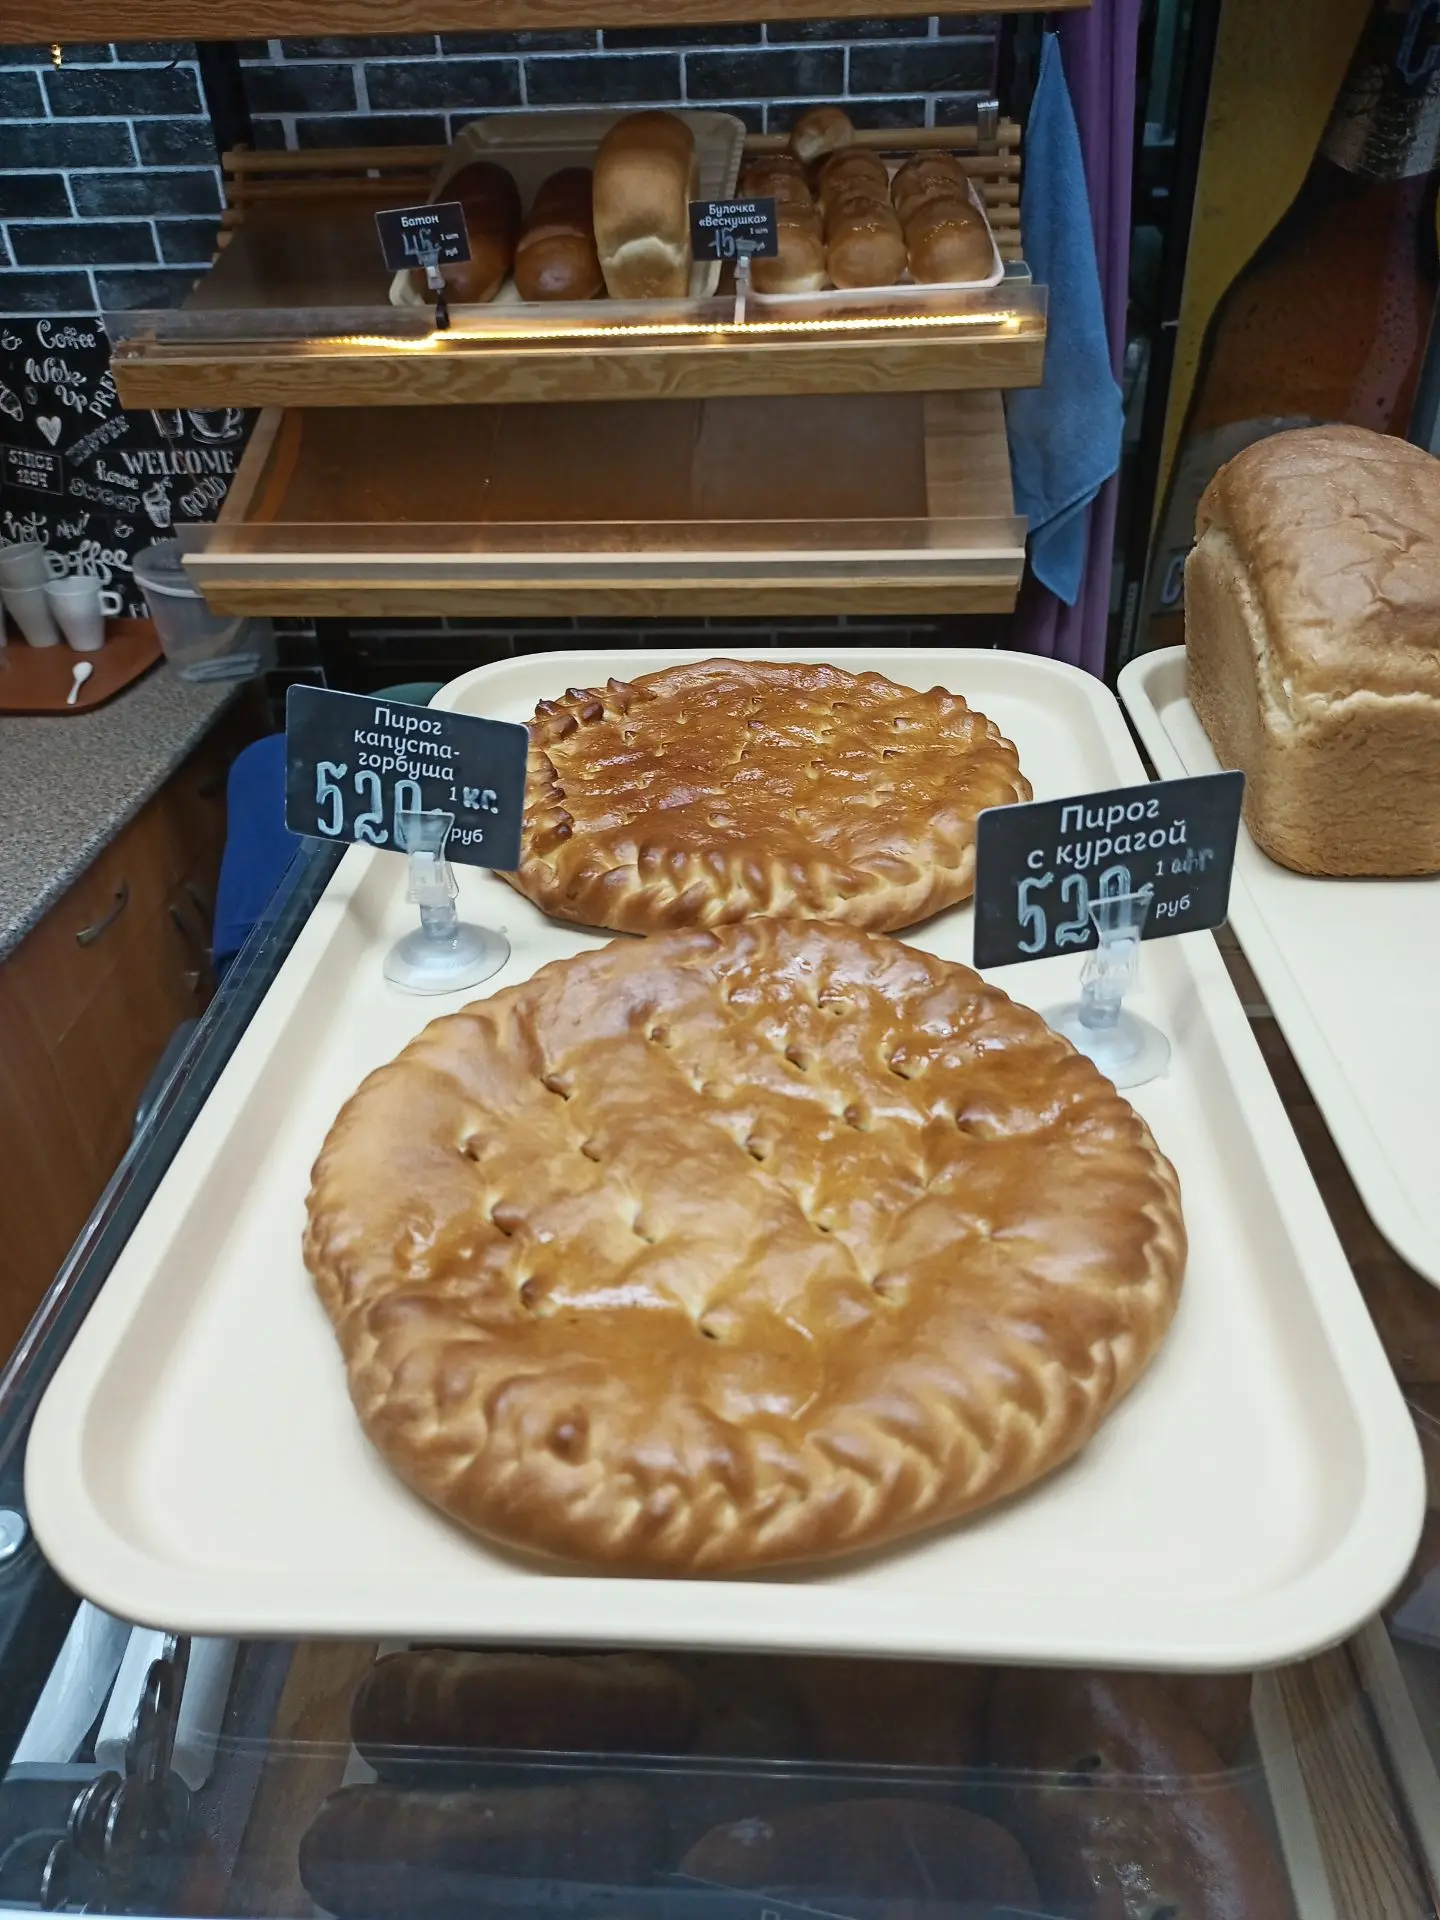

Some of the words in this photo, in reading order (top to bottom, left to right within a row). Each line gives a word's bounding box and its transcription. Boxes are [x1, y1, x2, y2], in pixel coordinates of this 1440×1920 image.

[401, 215, 439, 227] Батон
[699, 216, 767, 228] «Веснушка»
[709, 203, 755, 217] Булочка
[89, 370, 117, 419] PRE
[120, 450, 236, 475] WELCOME
[375, 706, 442, 735] Пирог
[354, 729, 460, 759] капуста-
[358, 752, 453, 780] горбуша
[449, 786, 457, 801] 1
[1060, 799, 1159, 833] Пирог
[451, 828, 483, 845] руб
[1027, 849, 1044, 869] с
[1056, 820, 1186, 870] курагой
[1155, 861, 1164, 876] 1
[1156, 895, 1190, 919] руб
